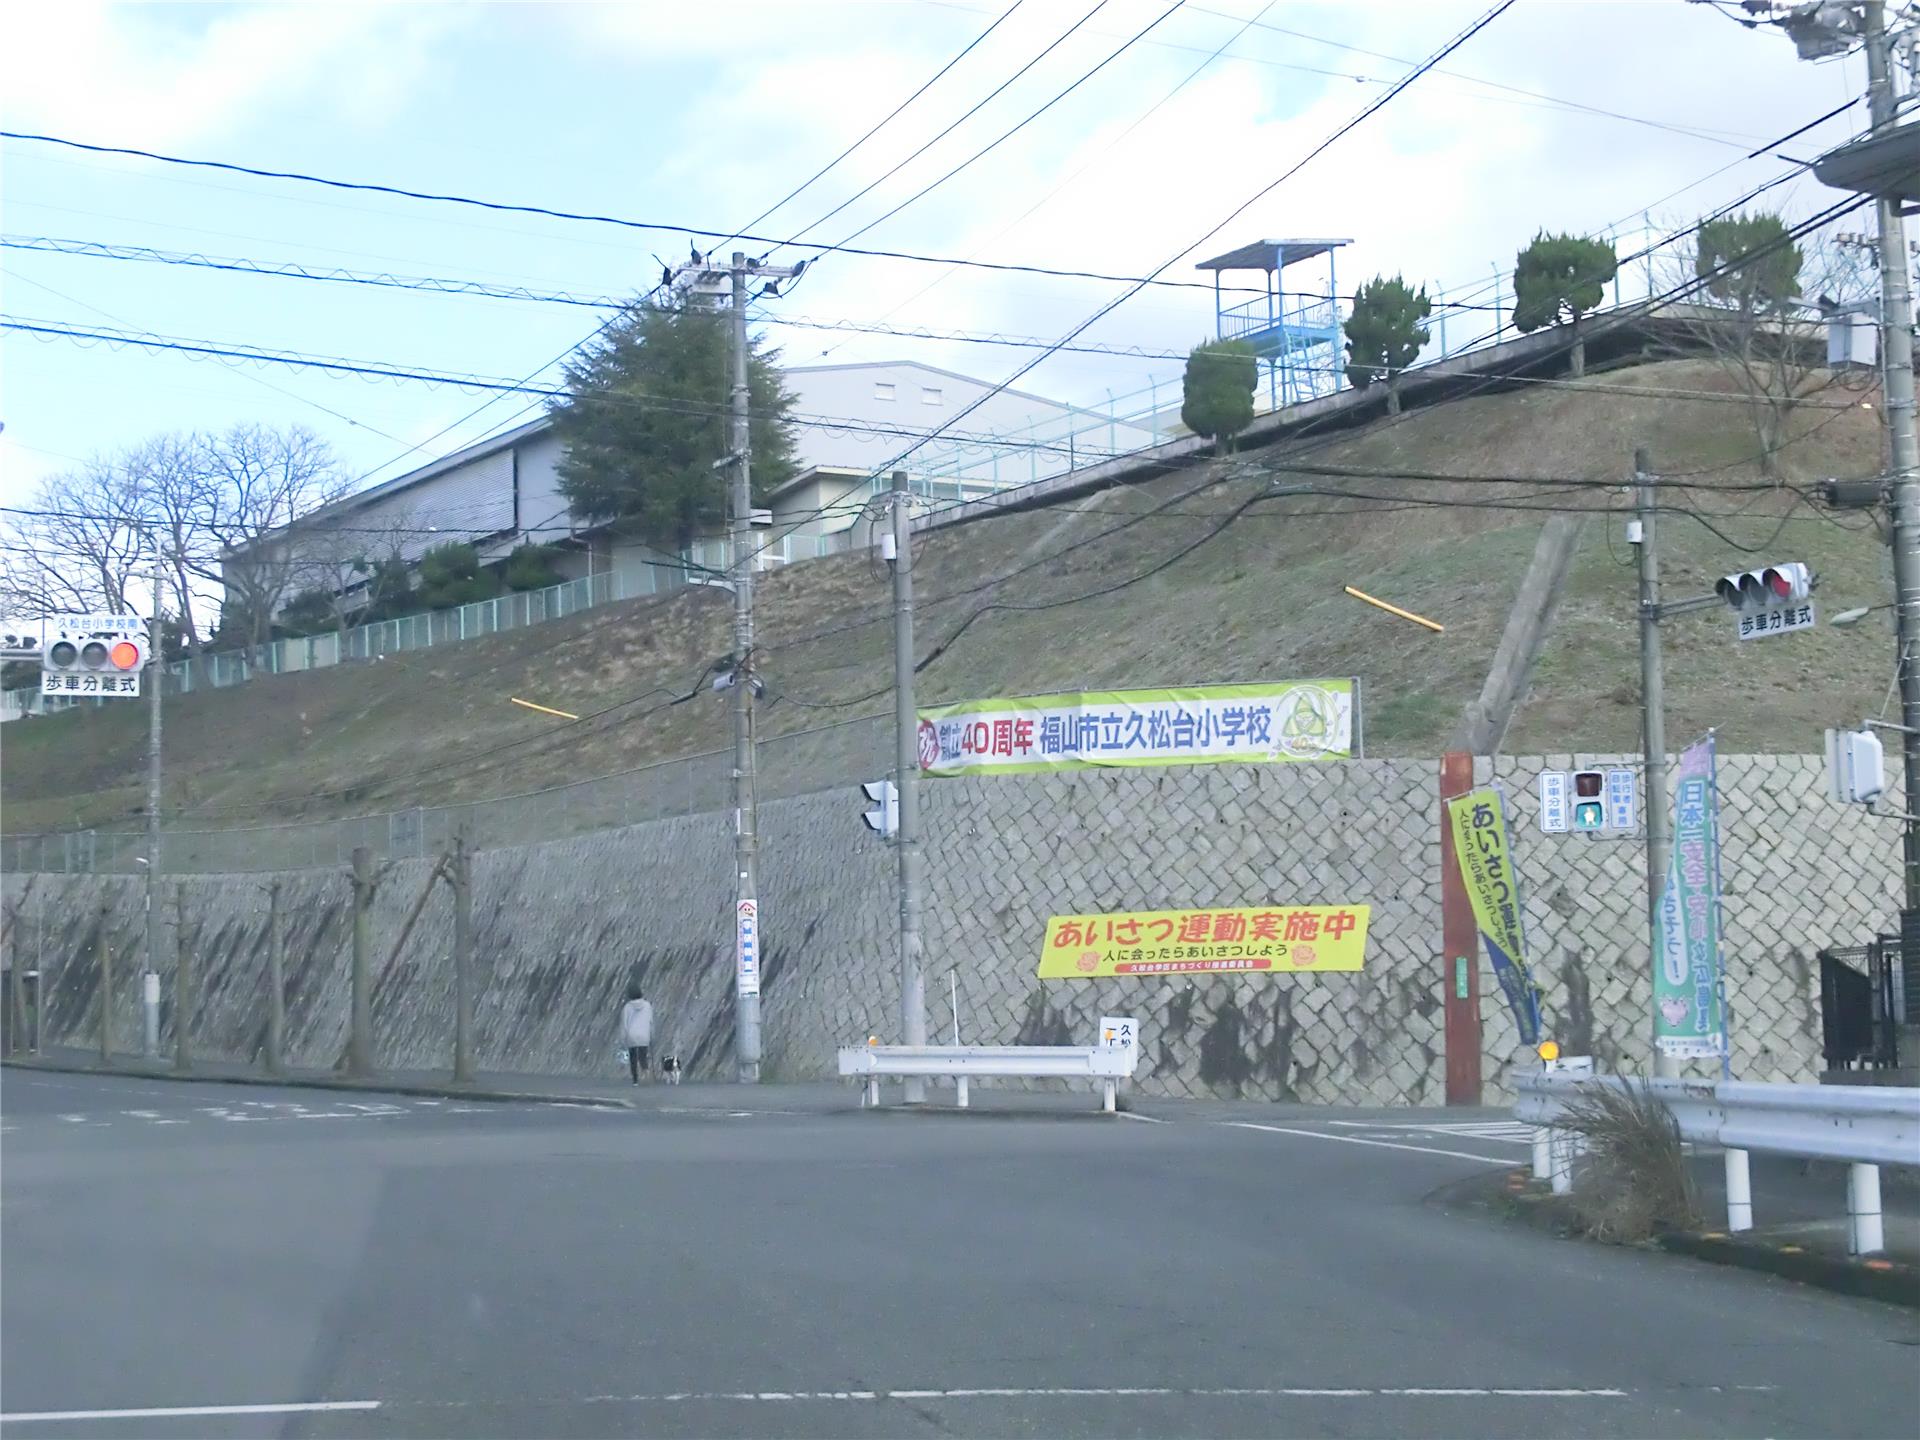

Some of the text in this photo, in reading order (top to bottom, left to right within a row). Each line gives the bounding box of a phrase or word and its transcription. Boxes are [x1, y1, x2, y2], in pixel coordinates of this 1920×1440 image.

[1741, 605, 1811, 635] 歩車分離式
[46, 675, 136, 692] 歩車分離式
[1040, 705, 1271, 754] 福山市立久松台小学校
[1053, 909, 1357, 948] あいさつ運動実施中
[1102, 943, 1289, 963] 人に会ったらあいさつしよう
